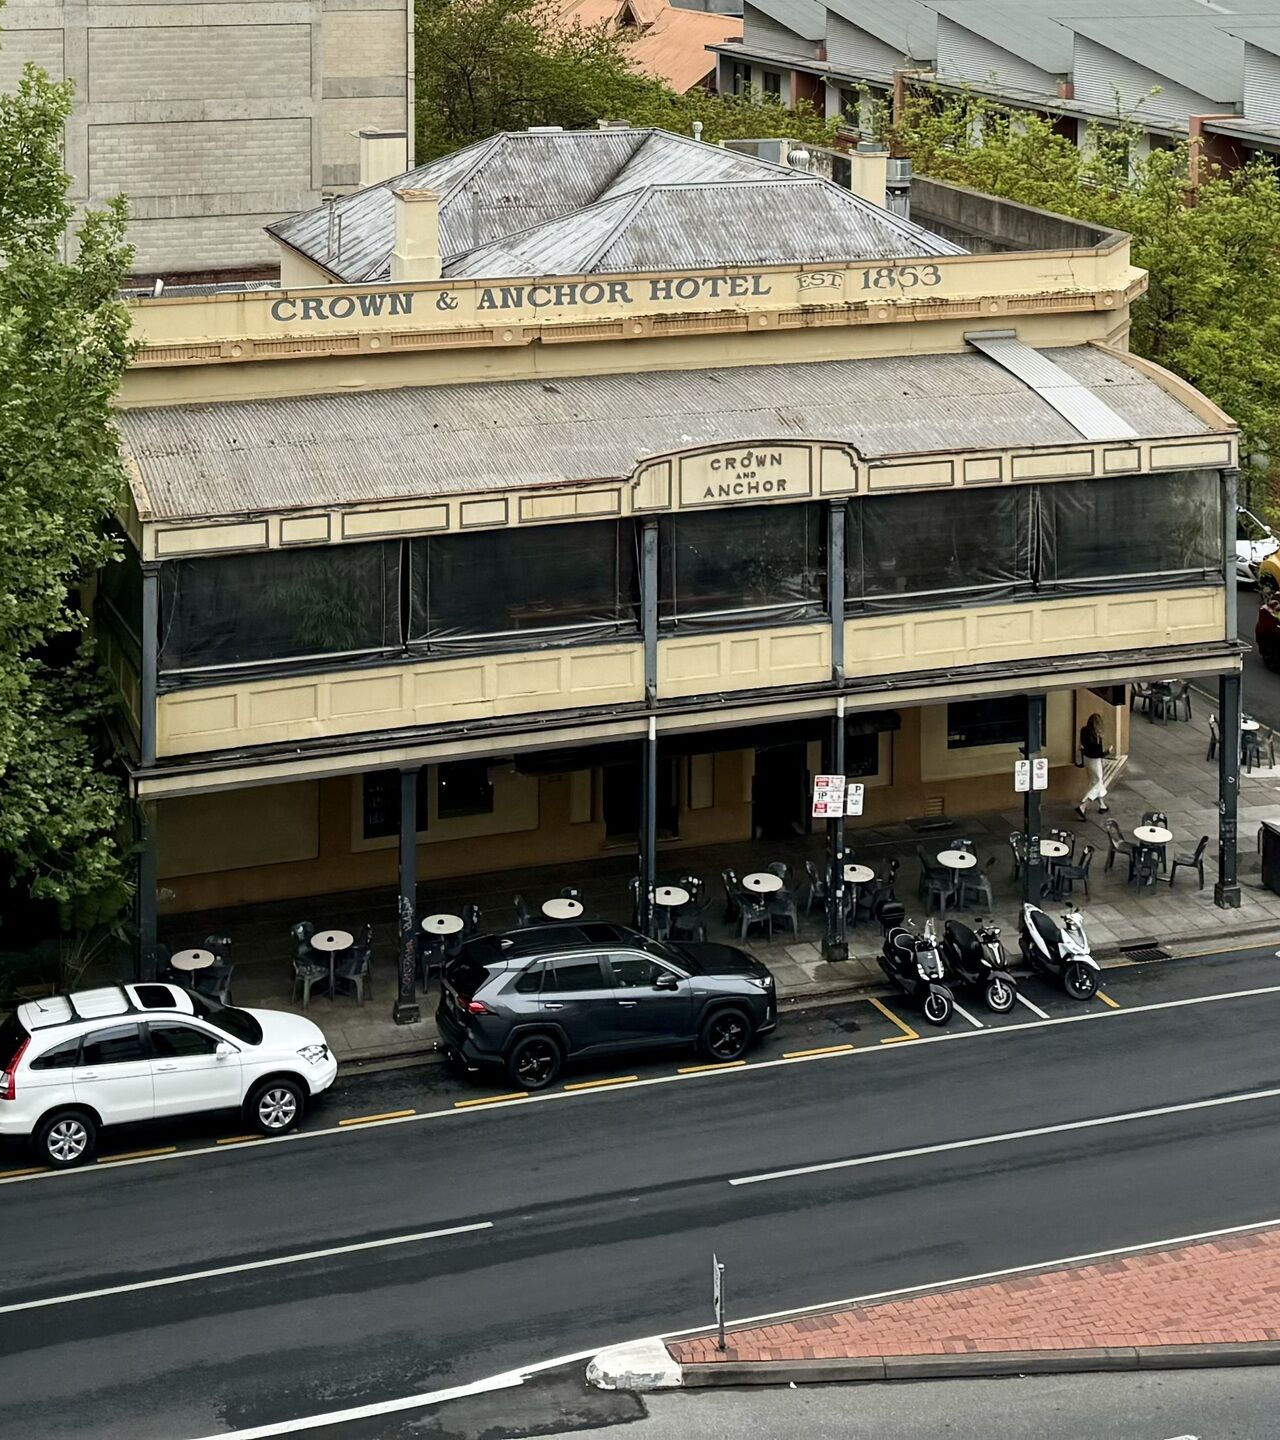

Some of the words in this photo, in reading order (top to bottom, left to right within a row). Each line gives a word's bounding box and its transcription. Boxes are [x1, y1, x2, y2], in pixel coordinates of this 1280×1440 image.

[271, 292, 414, 322] CROWN
[436, 291, 459, 311] &
[477, 280, 633, 310] ANCHOR
[649, 274, 773, 301] HOTEL
[861, 264, 942, 290] 1853
[710, 452, 783, 471] CROWN
[736, 470, 756, 480] AND
[704, 478, 787, 498] ANCHOR
